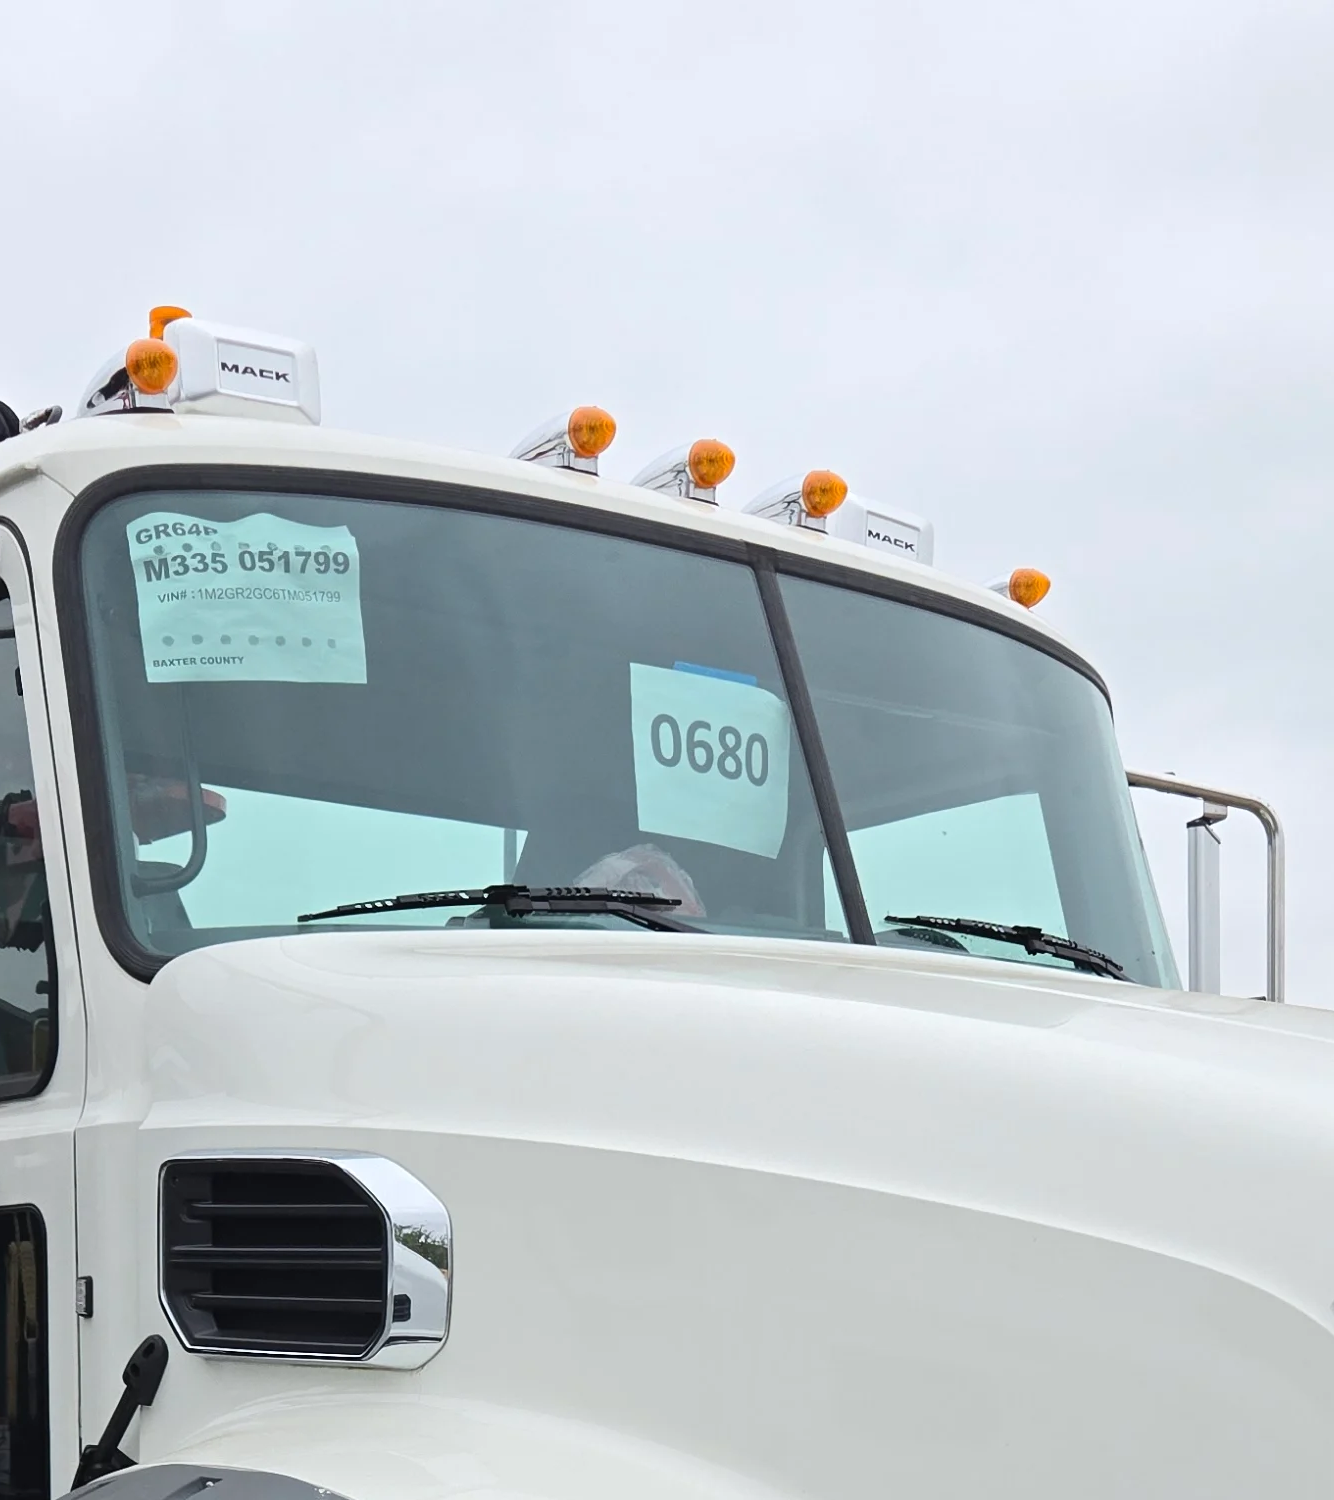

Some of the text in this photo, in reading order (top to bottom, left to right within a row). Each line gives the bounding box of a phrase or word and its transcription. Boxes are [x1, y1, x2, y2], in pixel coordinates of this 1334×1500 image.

[220, 361, 291, 383] MACK
[867, 529, 916, 552] MACK
[143, 550, 350, 583] M335 051799
[152, 656, 244, 668] BAXTER COUNTY
[650, 713, 769, 787] 0680
